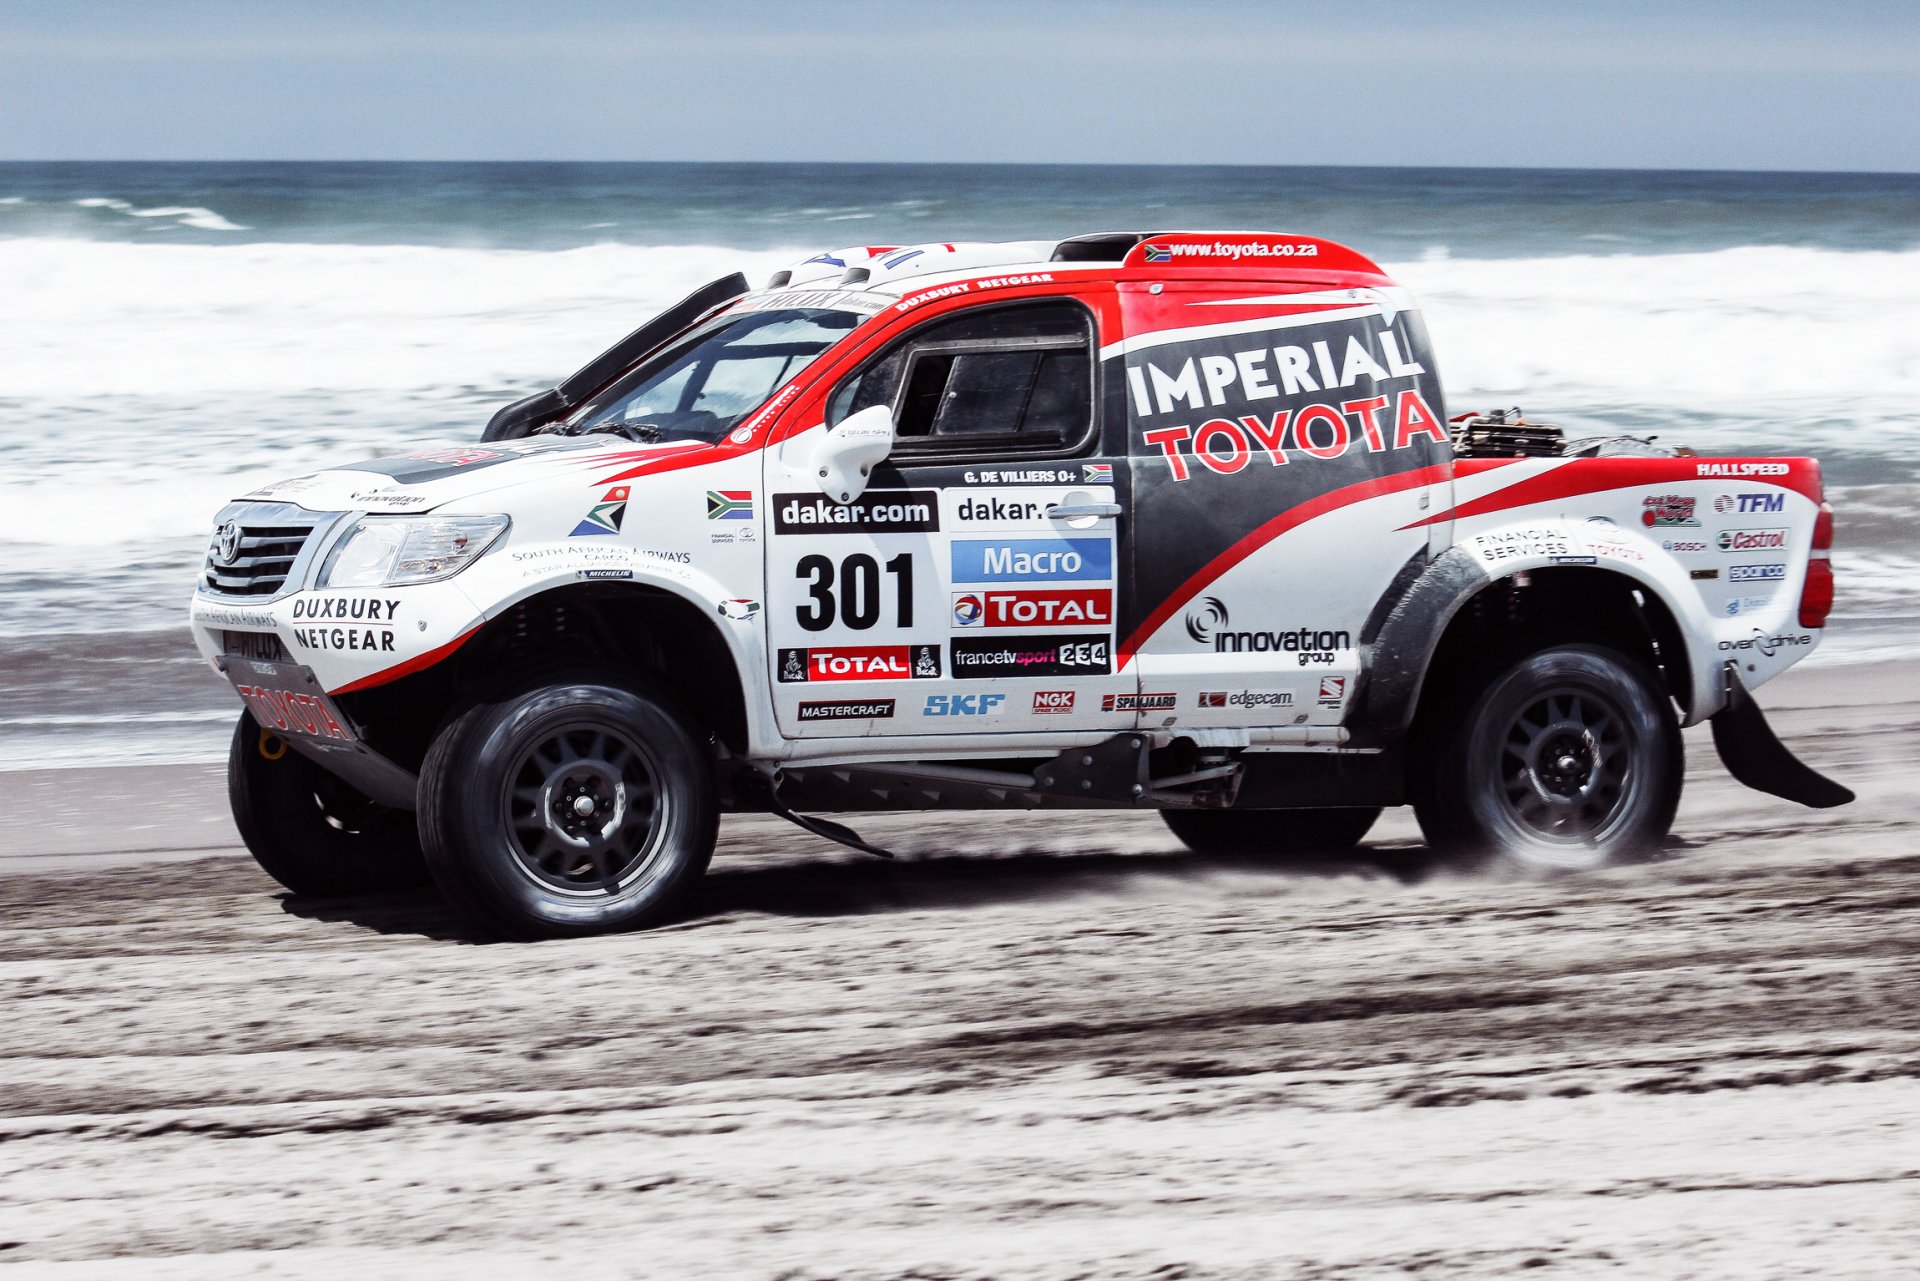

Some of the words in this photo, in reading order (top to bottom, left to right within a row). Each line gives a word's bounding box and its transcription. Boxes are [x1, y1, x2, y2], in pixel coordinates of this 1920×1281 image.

[1169, 241, 1318, 261] www.toyota.co.za
[761, 292, 843, 309] HILUX
[895, 283, 971, 312] DUXBURY
[976, 273, 1054, 289] NETGEAR
[1127, 329, 1426, 417] IMPERIAL
[1142, 388, 1450, 482] TOYOTA
[963, 471, 979, 483] G.
[980, 471, 999, 483] DE
[1000, 470, 1056, 483] VILLIERS
[1696, 463, 1791, 476] HALLSPEED
[781, 499, 931, 525] dakar.com
[1736, 493, 1786, 513] TFM
[1475, 529, 1568, 547] FINANCIAL
[1672, 542, 1708, 551] BOSCH
[1732, 530, 1786, 549] Castrol
[512, 548, 563, 561] SOUTH
[632, 547, 691, 564] AIRWAYS
[982, 547, 1082, 575] Macro
[1483, 543, 1568, 561] SERVICES
[1730, 565, 1785, 578] sparco
[794, 552, 914, 632] 301
[293, 598, 401, 620] DUXBURY
[989, 596, 1108, 622] TOTAL
[294, 628, 396, 651] NETGEAR
[1215, 627, 1350, 653] innovation
[811, 652, 908, 674] TOTAL
[1298, 652, 1335, 666] group
[923, 694, 1006, 717] SKF
[1035, 692, 1074, 707] NGK
[1229, 689, 1293, 709] edgecam
[237, 684, 351, 741] TOYOTA
[801, 704, 891, 718] MASTERCRAFT
